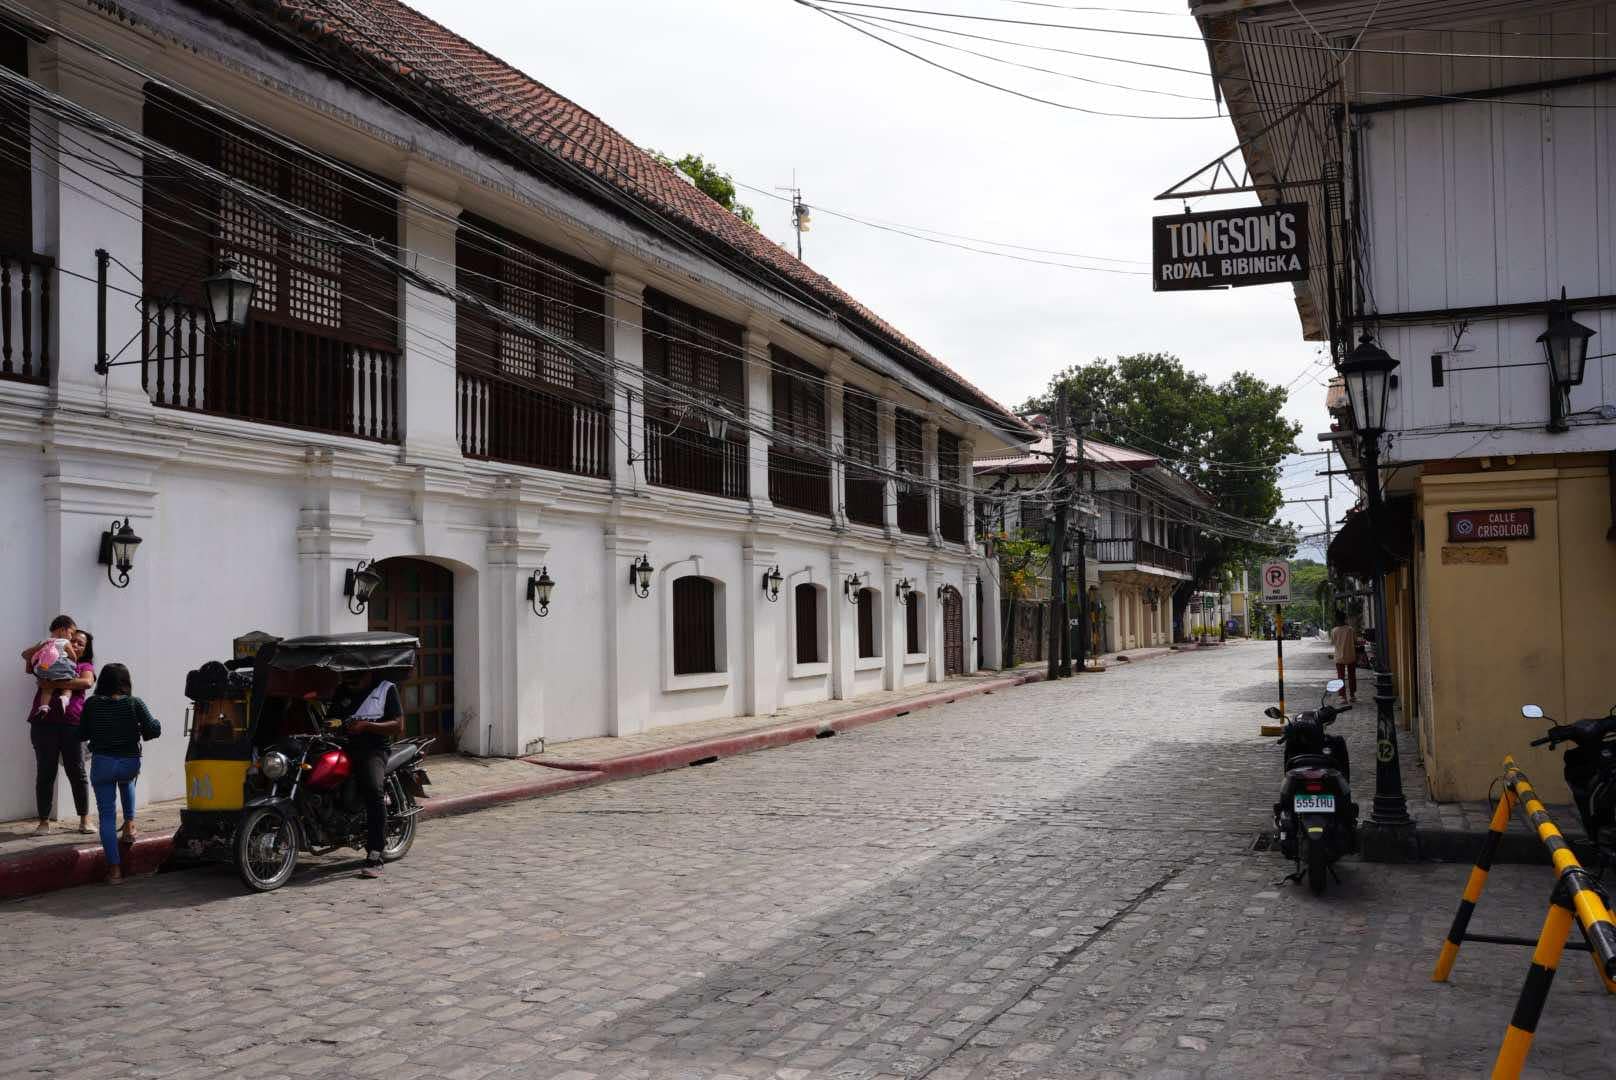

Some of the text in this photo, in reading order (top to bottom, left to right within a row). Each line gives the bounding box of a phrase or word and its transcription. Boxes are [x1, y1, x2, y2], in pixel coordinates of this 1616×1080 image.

[1166, 211, 1296, 258] TONGSON'S
[1162, 253, 1302, 281] ROYAL BIBINGKA
[1489, 512, 1516, 523] CALLE
[1477, 523, 1529, 538] CRISOLOGO
